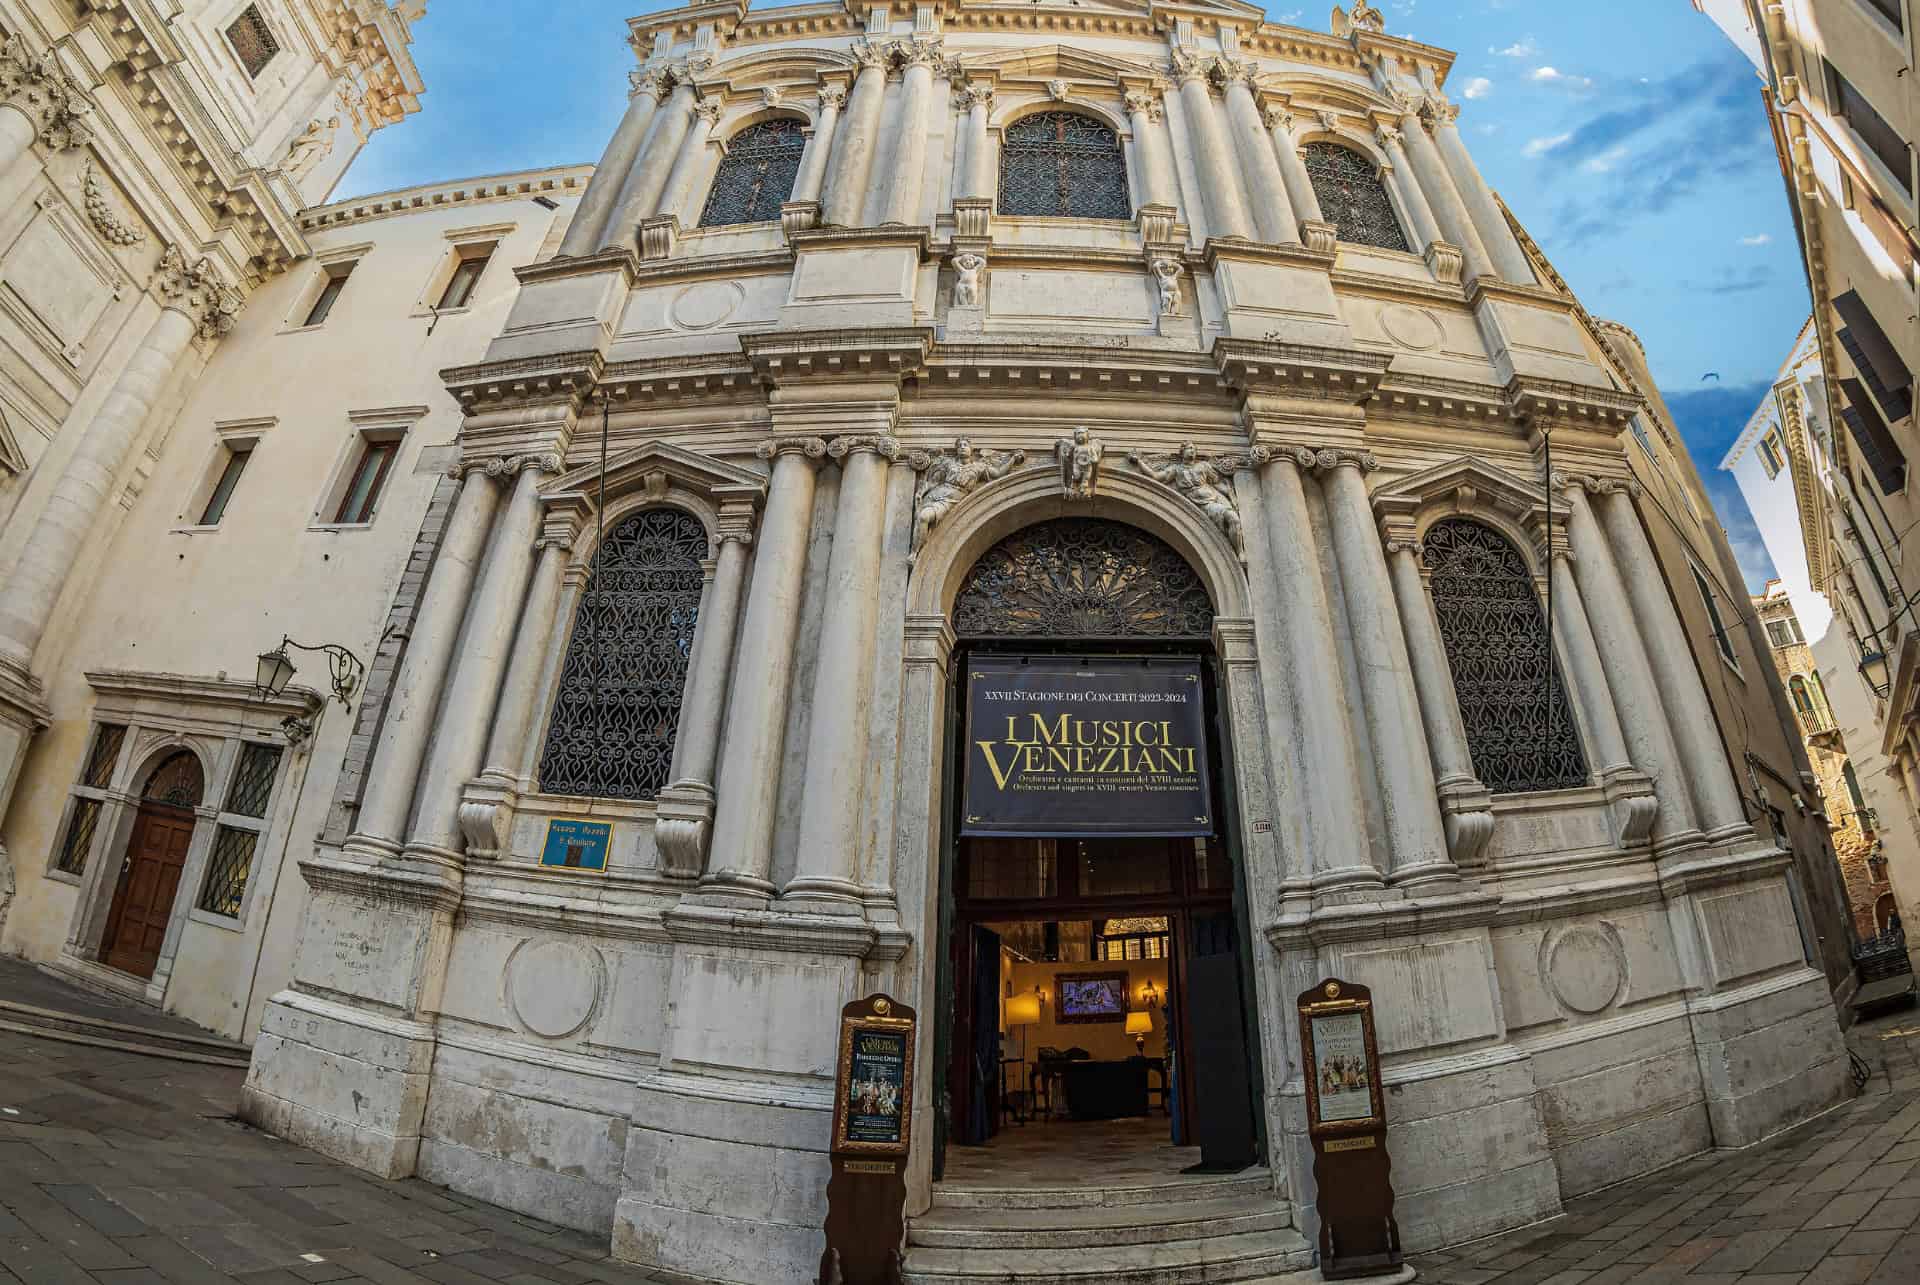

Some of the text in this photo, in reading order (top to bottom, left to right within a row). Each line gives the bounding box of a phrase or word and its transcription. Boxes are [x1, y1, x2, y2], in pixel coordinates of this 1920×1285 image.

[1005, 713, 1174, 746] I MUSICI
[975, 741, 1199, 791] VENEZIANI
